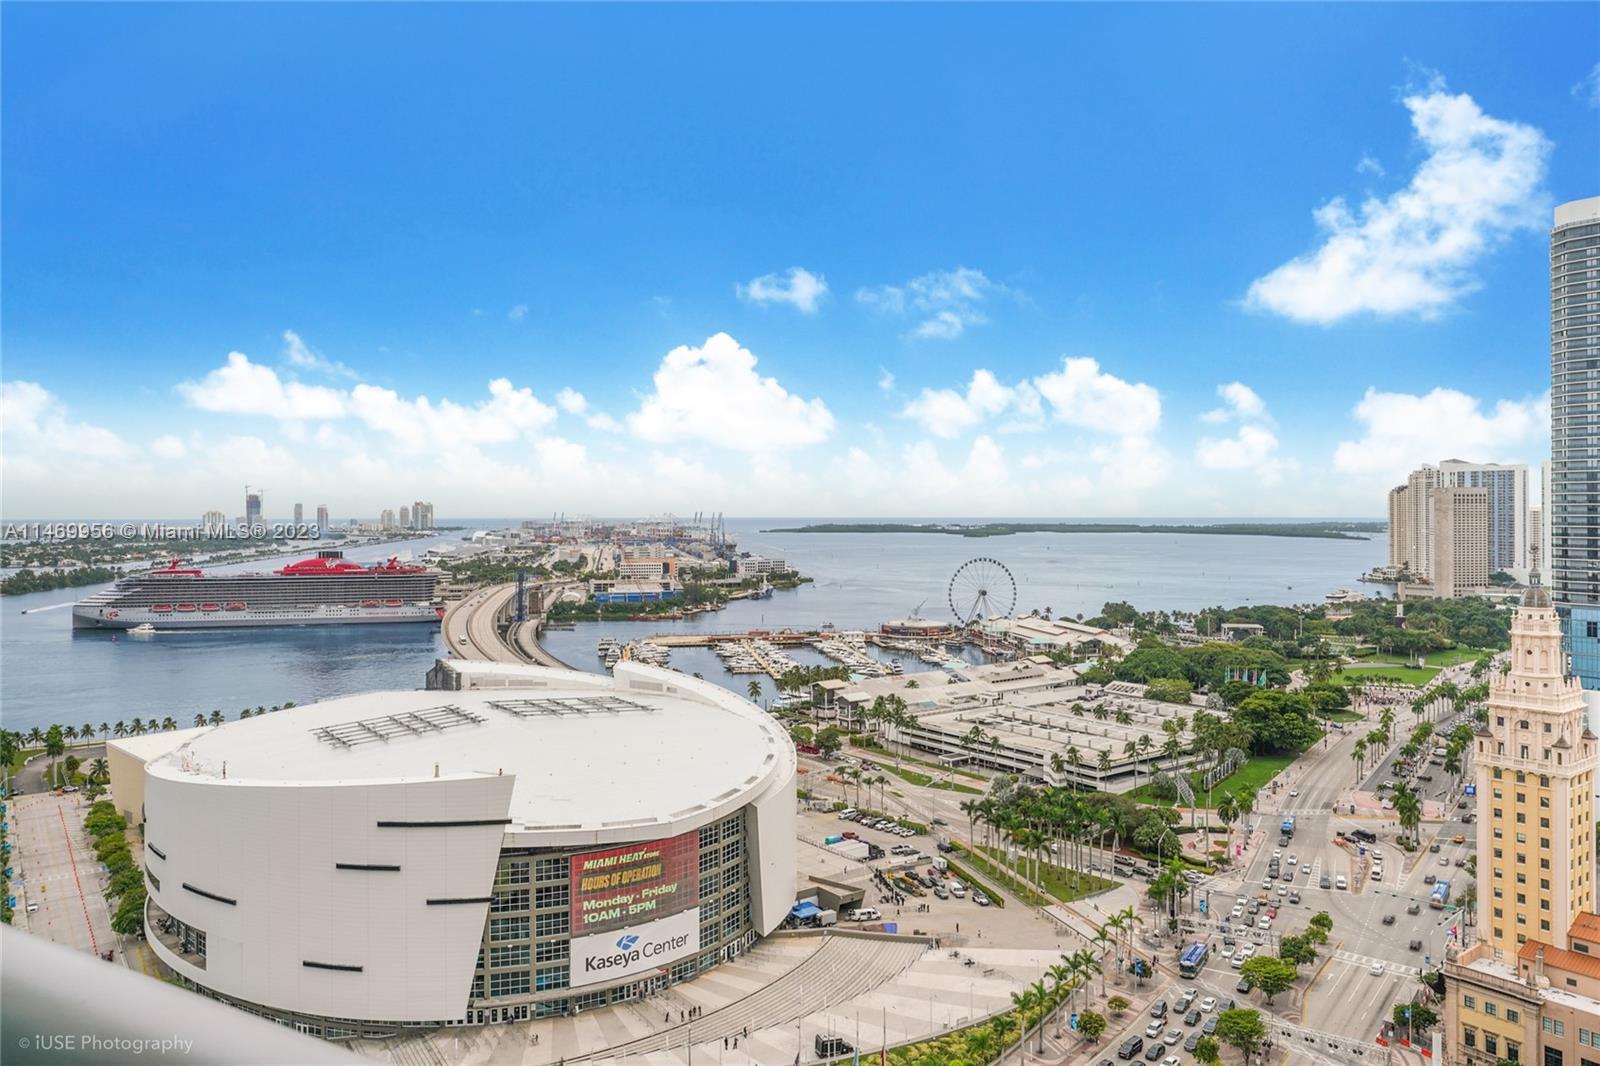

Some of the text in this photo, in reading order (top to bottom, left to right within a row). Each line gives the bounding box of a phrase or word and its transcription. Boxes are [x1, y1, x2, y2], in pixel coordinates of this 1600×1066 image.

[583, 856, 618, 870] MIAMI
[619, 848, 646, 864] HEAT
[581, 863, 662, 891] HOURS OF OPERATION
[583, 893, 634, 910] Monday
[642, 883, 678, 899] Friday
[583, 908, 620, 923] 10AM
[629, 900, 656, 915] 5PM
[585, 933, 689, 972] Kaseya Center
